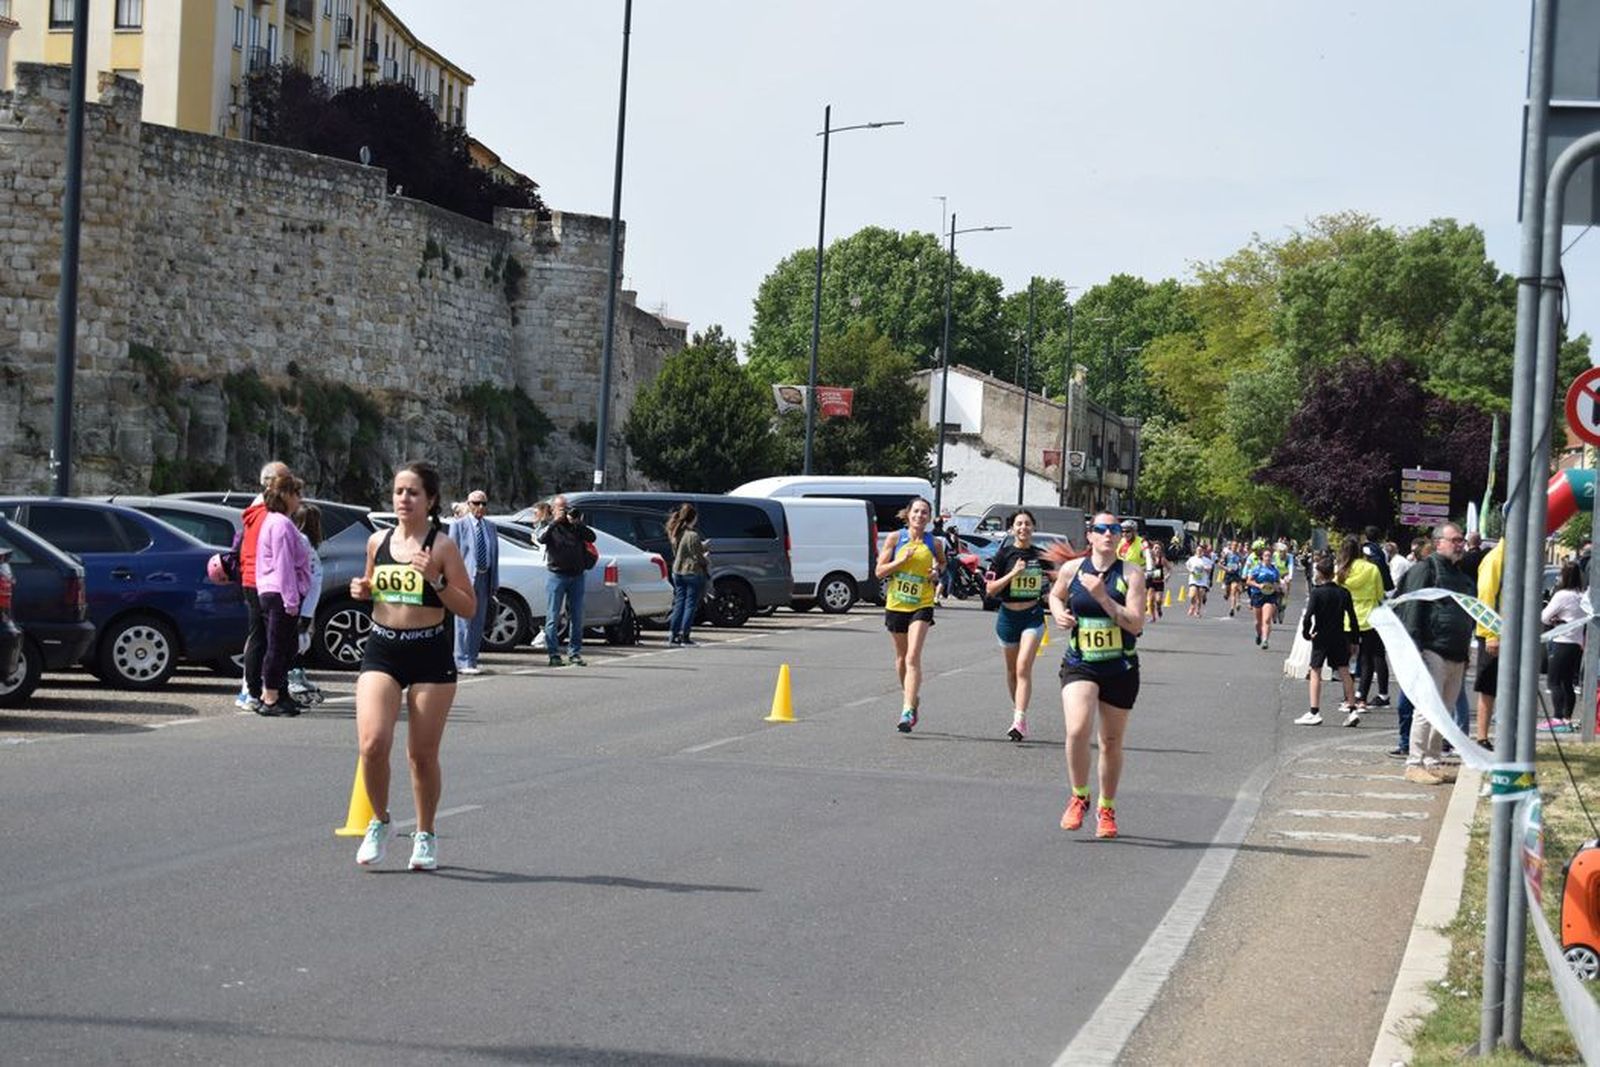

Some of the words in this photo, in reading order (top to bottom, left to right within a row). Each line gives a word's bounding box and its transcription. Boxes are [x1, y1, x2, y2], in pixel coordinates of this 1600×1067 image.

[376, 571, 416, 592] 663
[897, 580, 918, 596] 166
[1015, 577, 1036, 589] 119
[400, 628, 434, 640] NIKE
[1084, 630, 1113, 648] 161
